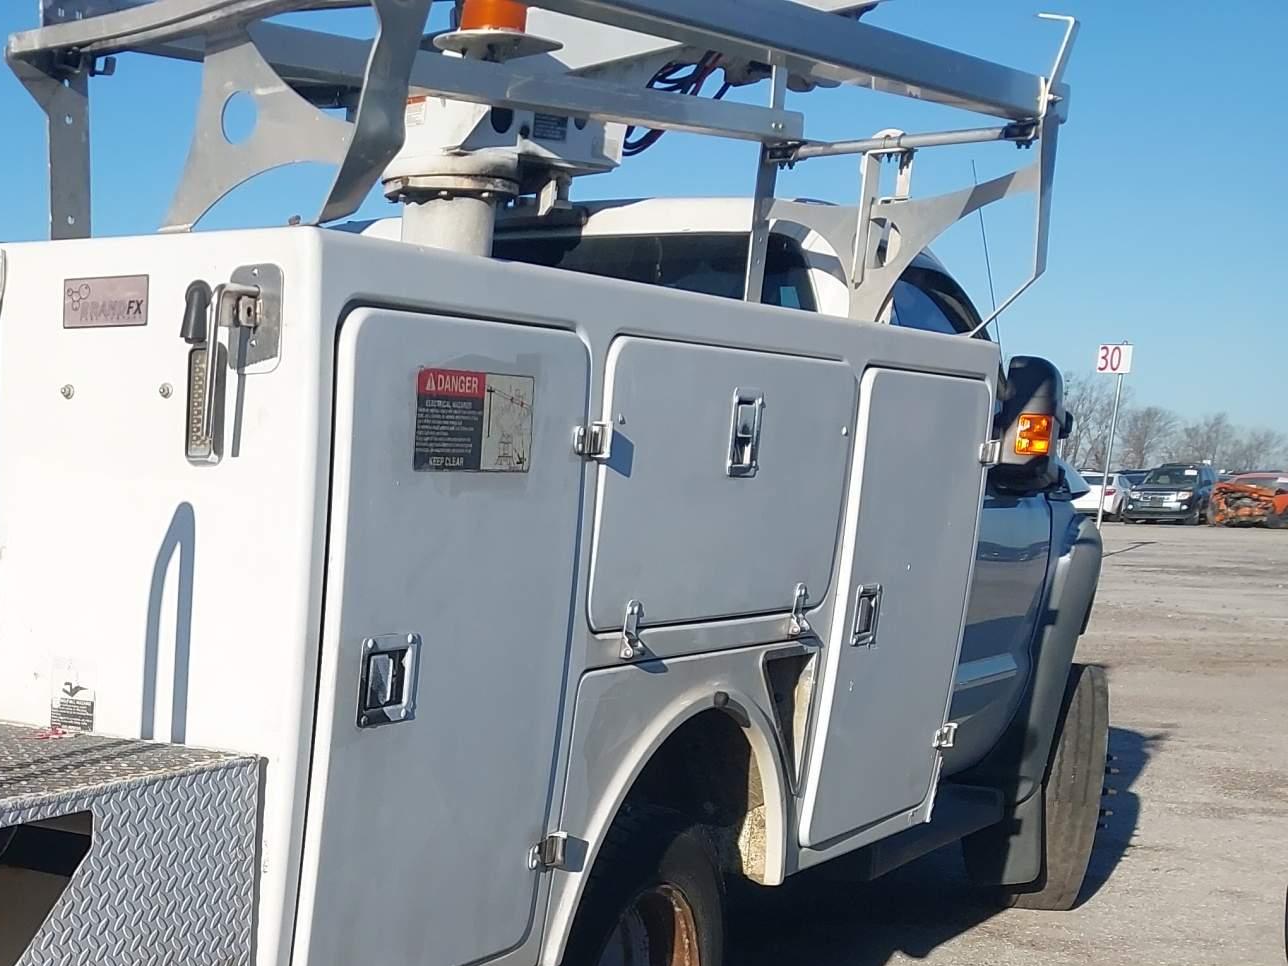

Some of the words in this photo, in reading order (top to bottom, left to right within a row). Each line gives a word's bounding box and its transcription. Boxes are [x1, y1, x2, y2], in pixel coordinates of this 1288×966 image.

[1097, 345, 1122, 371] 30
[437, 374, 479, 393] DANGER
[445, 457, 464, 467] CLEAR
